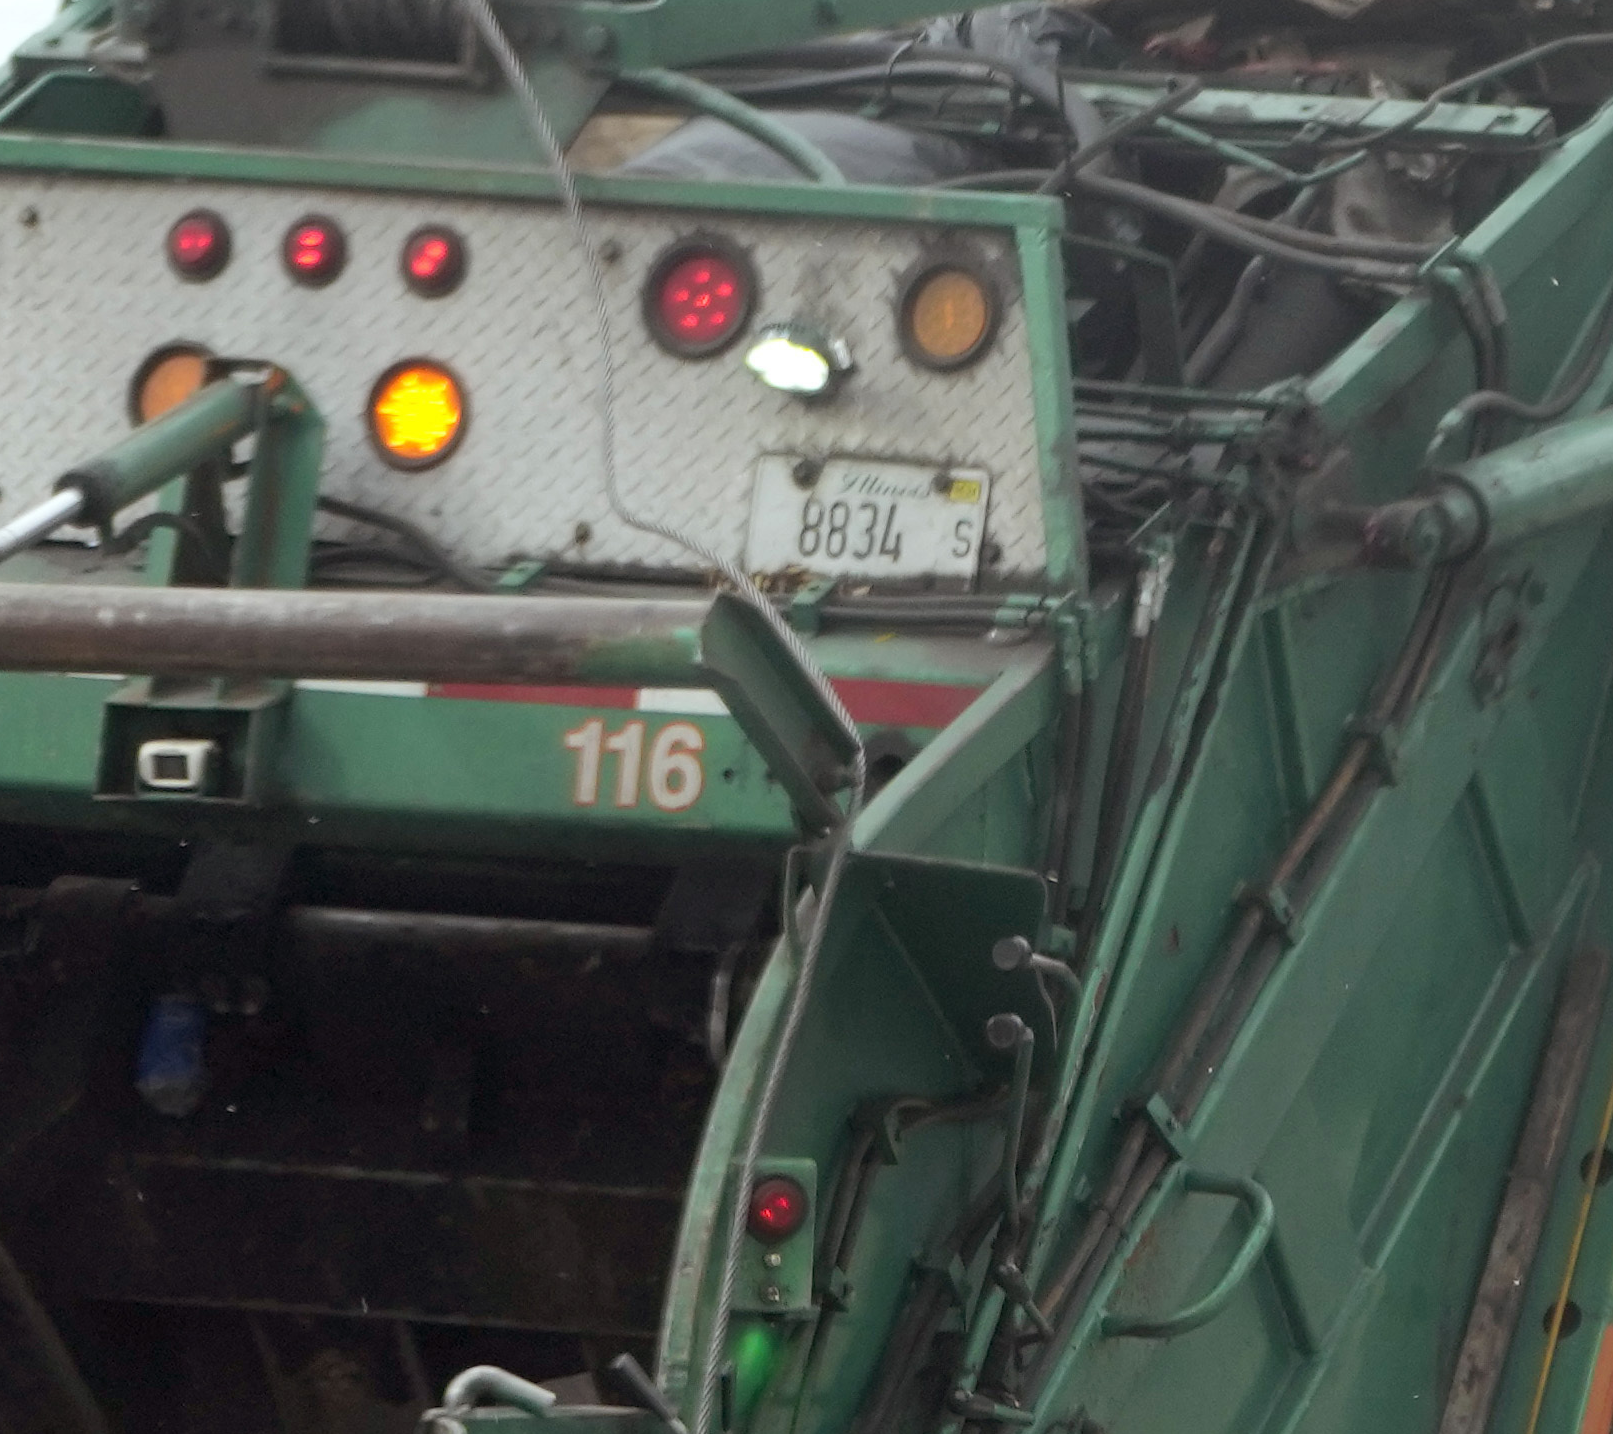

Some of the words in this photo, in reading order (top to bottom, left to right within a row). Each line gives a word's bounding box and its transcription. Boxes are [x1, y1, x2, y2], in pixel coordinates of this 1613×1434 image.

[798, 498, 902, 564] 8834
[952, 519, 973, 558] S
[564, 718, 705, 812] 116
